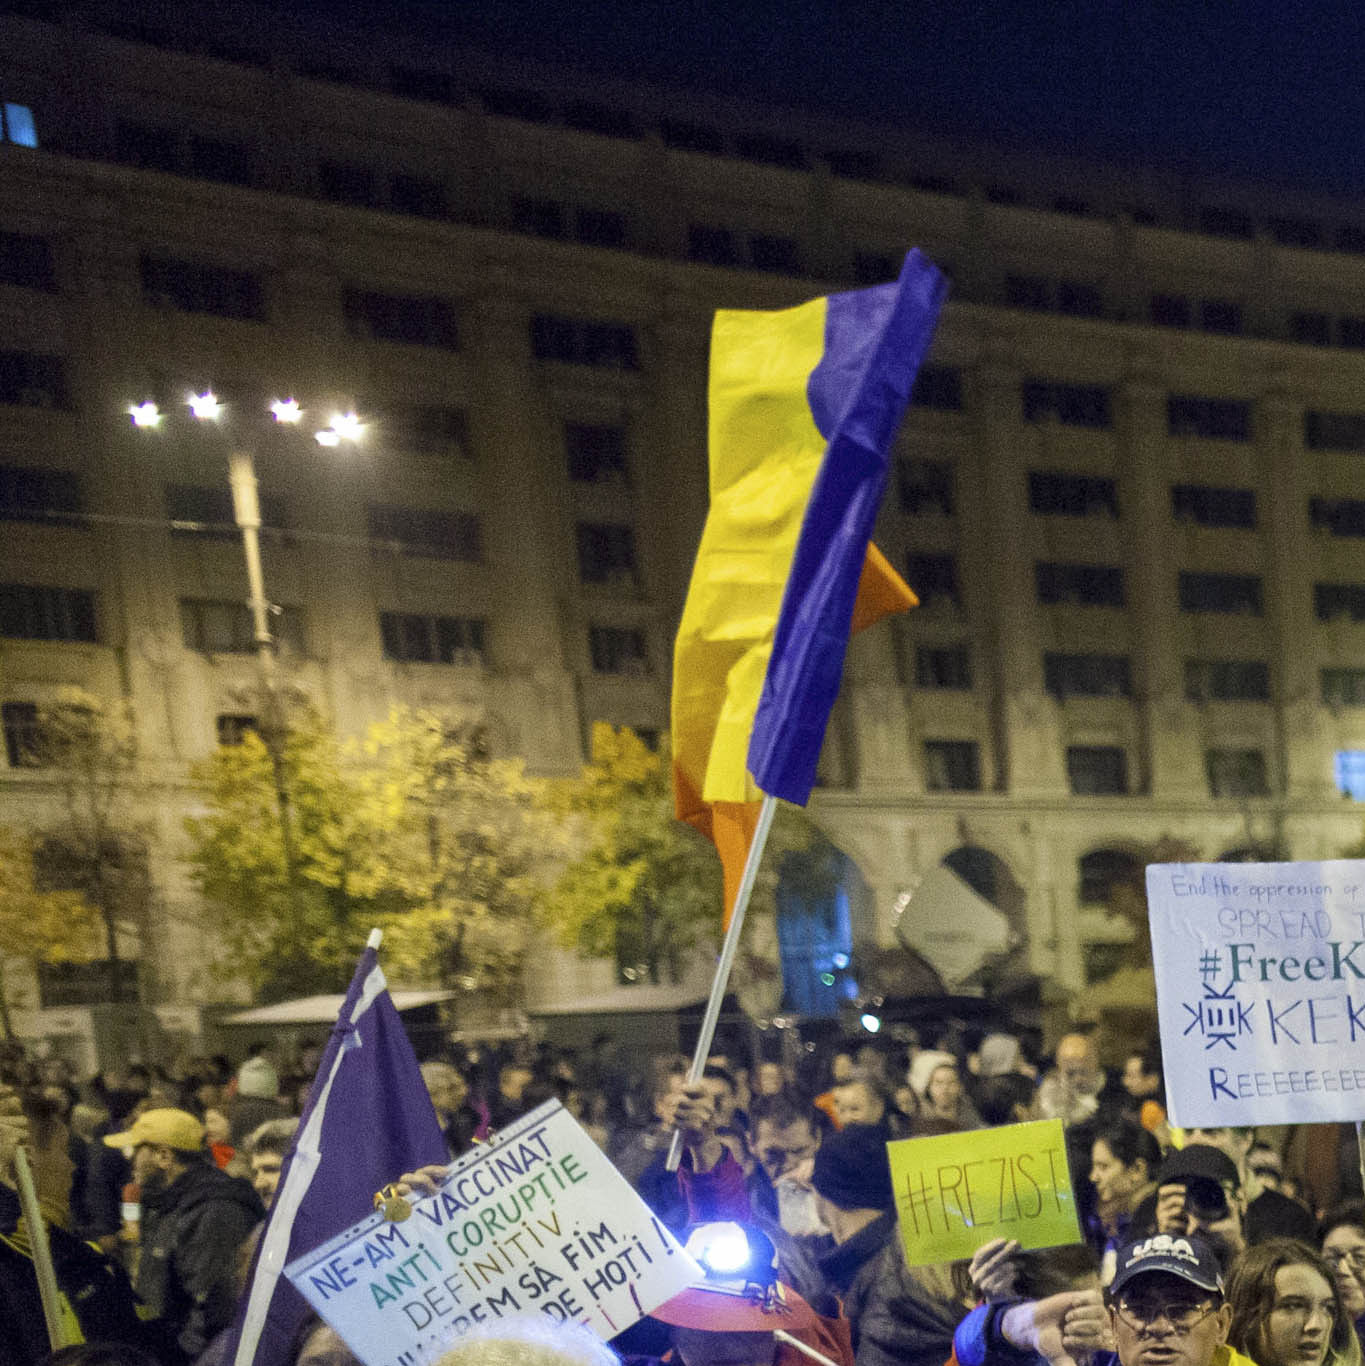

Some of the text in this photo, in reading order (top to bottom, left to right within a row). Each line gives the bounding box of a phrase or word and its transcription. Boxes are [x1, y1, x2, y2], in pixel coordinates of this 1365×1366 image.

[1217, 906, 1333, 939] SPREAD
[309, 1126, 554, 1301] NE-AM VACCINAT
[367, 1153, 589, 1311] ANTI CORUPȚIE
[901, 1148, 1062, 1235] #REZIST
[400, 1210, 565, 1332] DEFINITIV
[517, 1264, 563, 1301] SĂ
